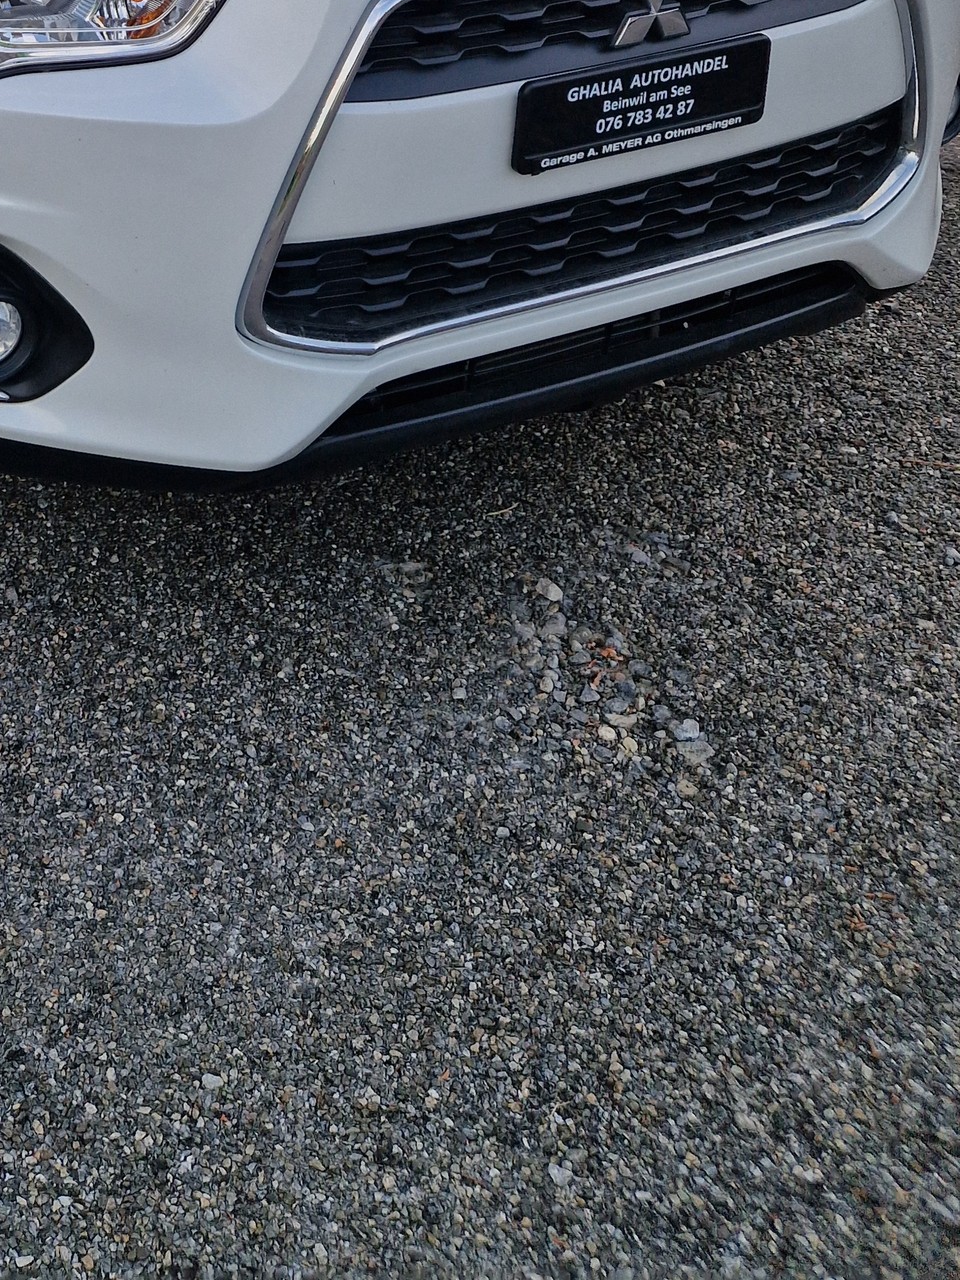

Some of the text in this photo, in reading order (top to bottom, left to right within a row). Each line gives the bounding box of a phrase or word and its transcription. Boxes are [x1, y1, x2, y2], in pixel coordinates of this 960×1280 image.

[567, 55, 729, 103] GHALIA AUTOHANDEL
[603, 84, 692, 113] Beinwil am See
[596, 99, 695, 134] 076 783 42 87
[541, 115, 742, 169] Garage A. MEYER AG Othmarsingen
